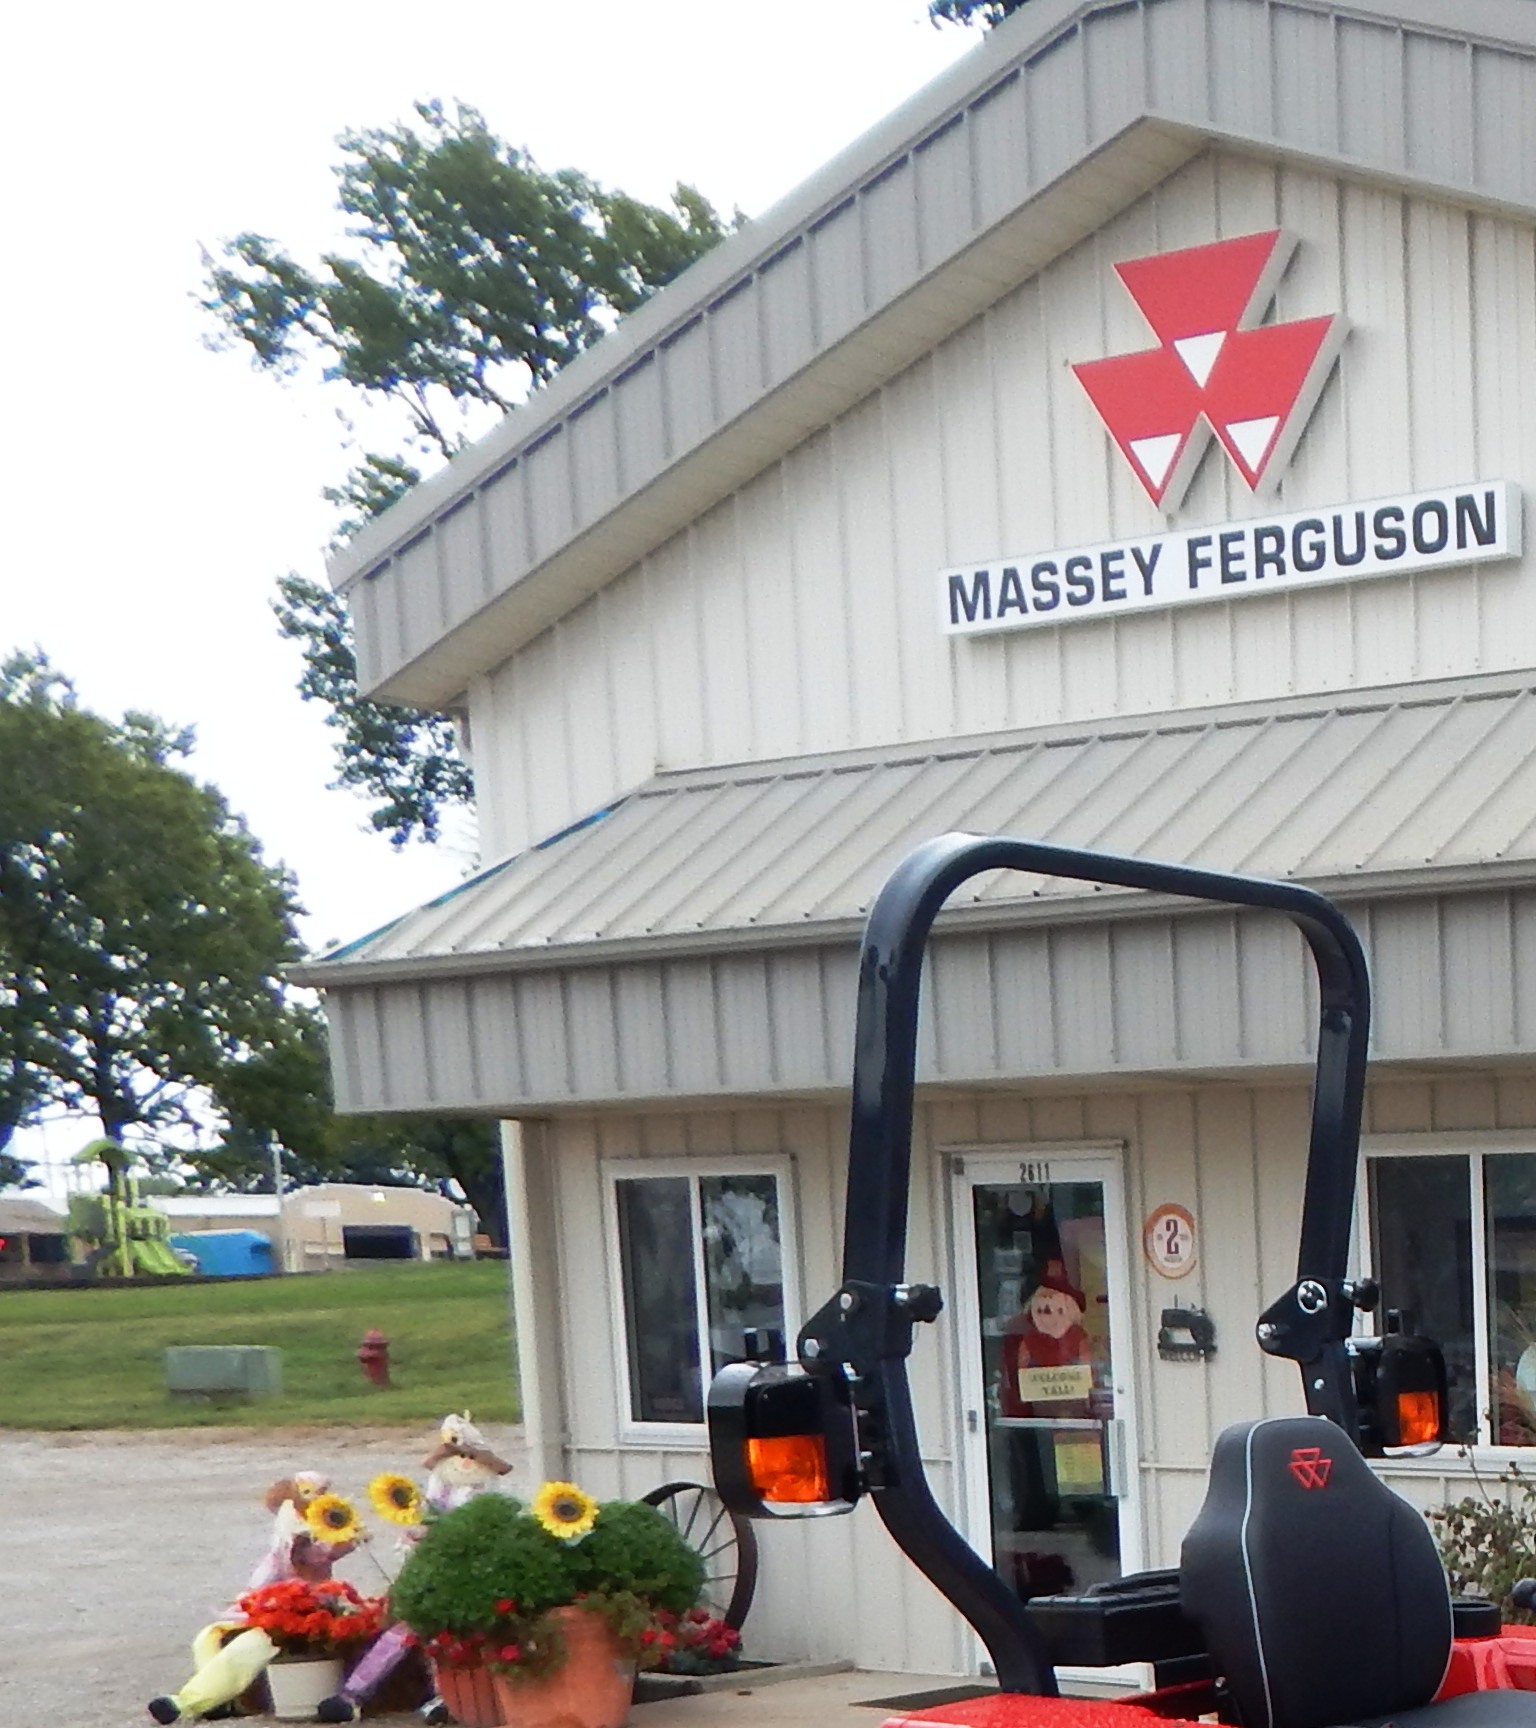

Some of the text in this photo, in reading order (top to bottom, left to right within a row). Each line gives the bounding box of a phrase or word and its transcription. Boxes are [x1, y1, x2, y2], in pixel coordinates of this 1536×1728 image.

[947, 491, 1498, 624] MASSEY FERGUSON
[1019, 1162, 1050, 1182] 2611
[1165, 1219, 1179, 1255] 2
